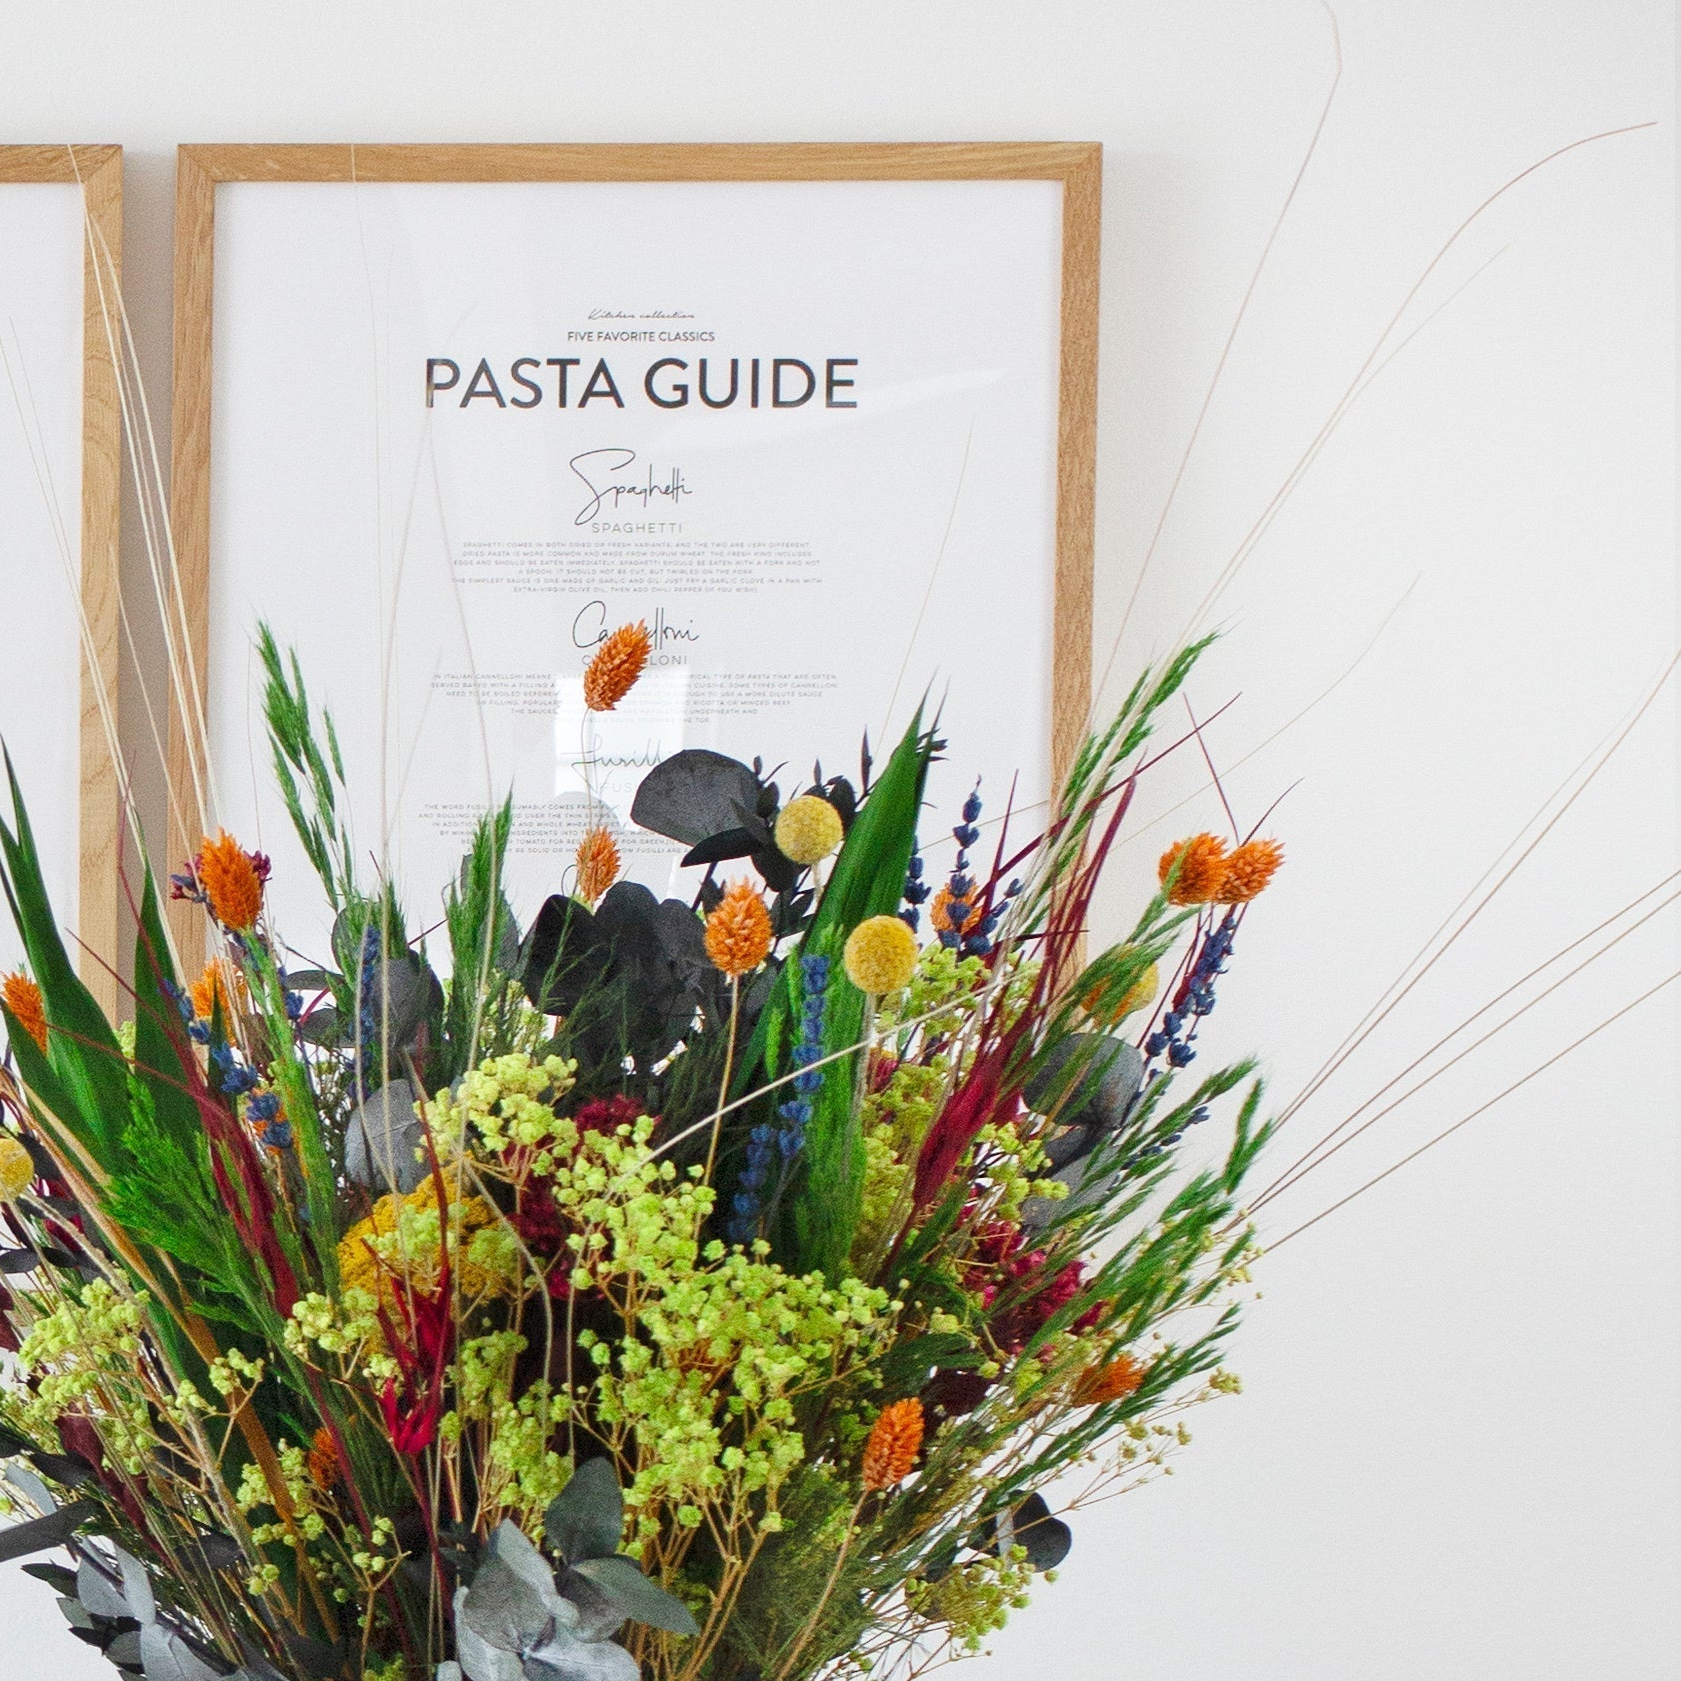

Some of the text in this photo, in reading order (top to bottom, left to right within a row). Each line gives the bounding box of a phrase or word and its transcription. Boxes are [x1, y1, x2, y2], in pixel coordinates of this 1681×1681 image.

[640, 309, 695, 319] collection
[567, 331, 715, 342] FIVE FAVORITE CLASSICS
[427, 358, 858, 409] PASTA GUIDE
[570, 449, 693, 526] Spaghetti
[592, 523, 683, 534] SPAGHETTI
[561, 733, 671, 794] Fusill
